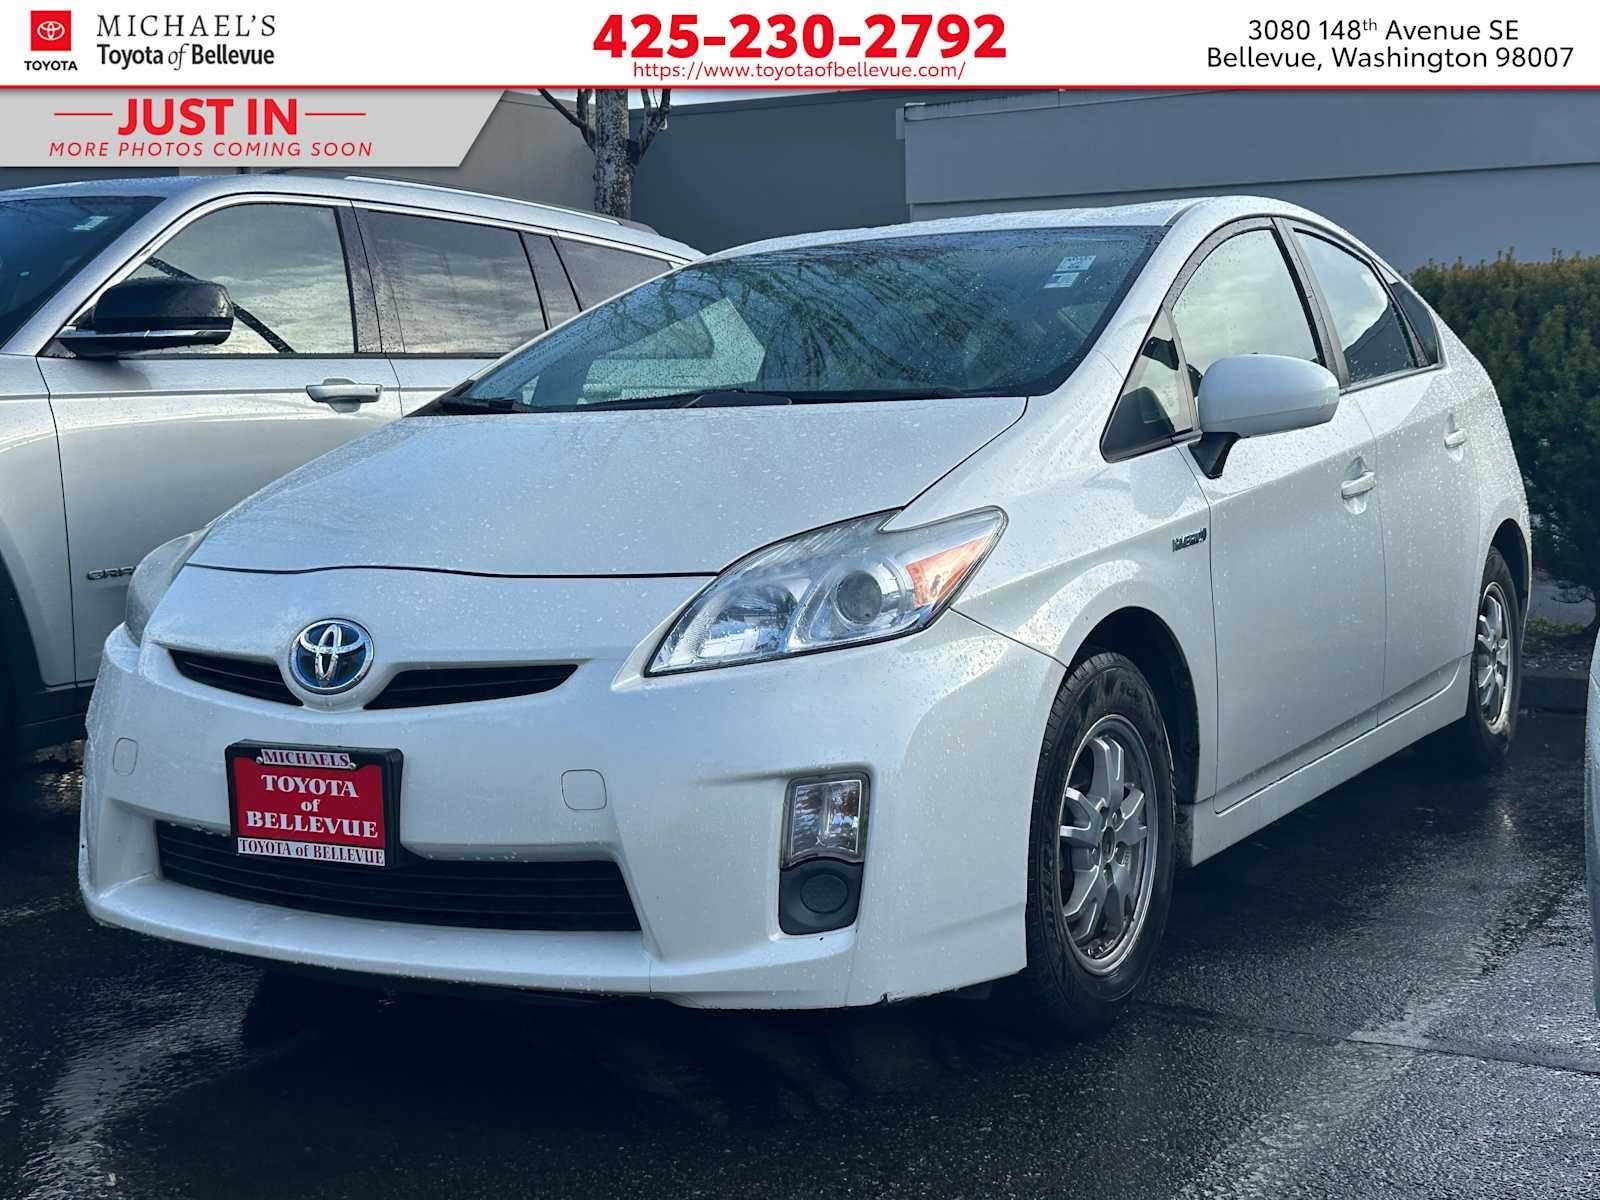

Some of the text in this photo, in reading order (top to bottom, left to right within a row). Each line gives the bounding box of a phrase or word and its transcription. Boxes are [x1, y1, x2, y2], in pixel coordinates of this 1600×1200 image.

[263, 751, 349, 767] MICHAELS
[261, 774, 359, 798] TOYOTA
[300, 799, 320, 812] of
[246, 810, 378, 839] BELLEVUE
[239, 838, 384, 865] TOYOTA of BELLEVUE
